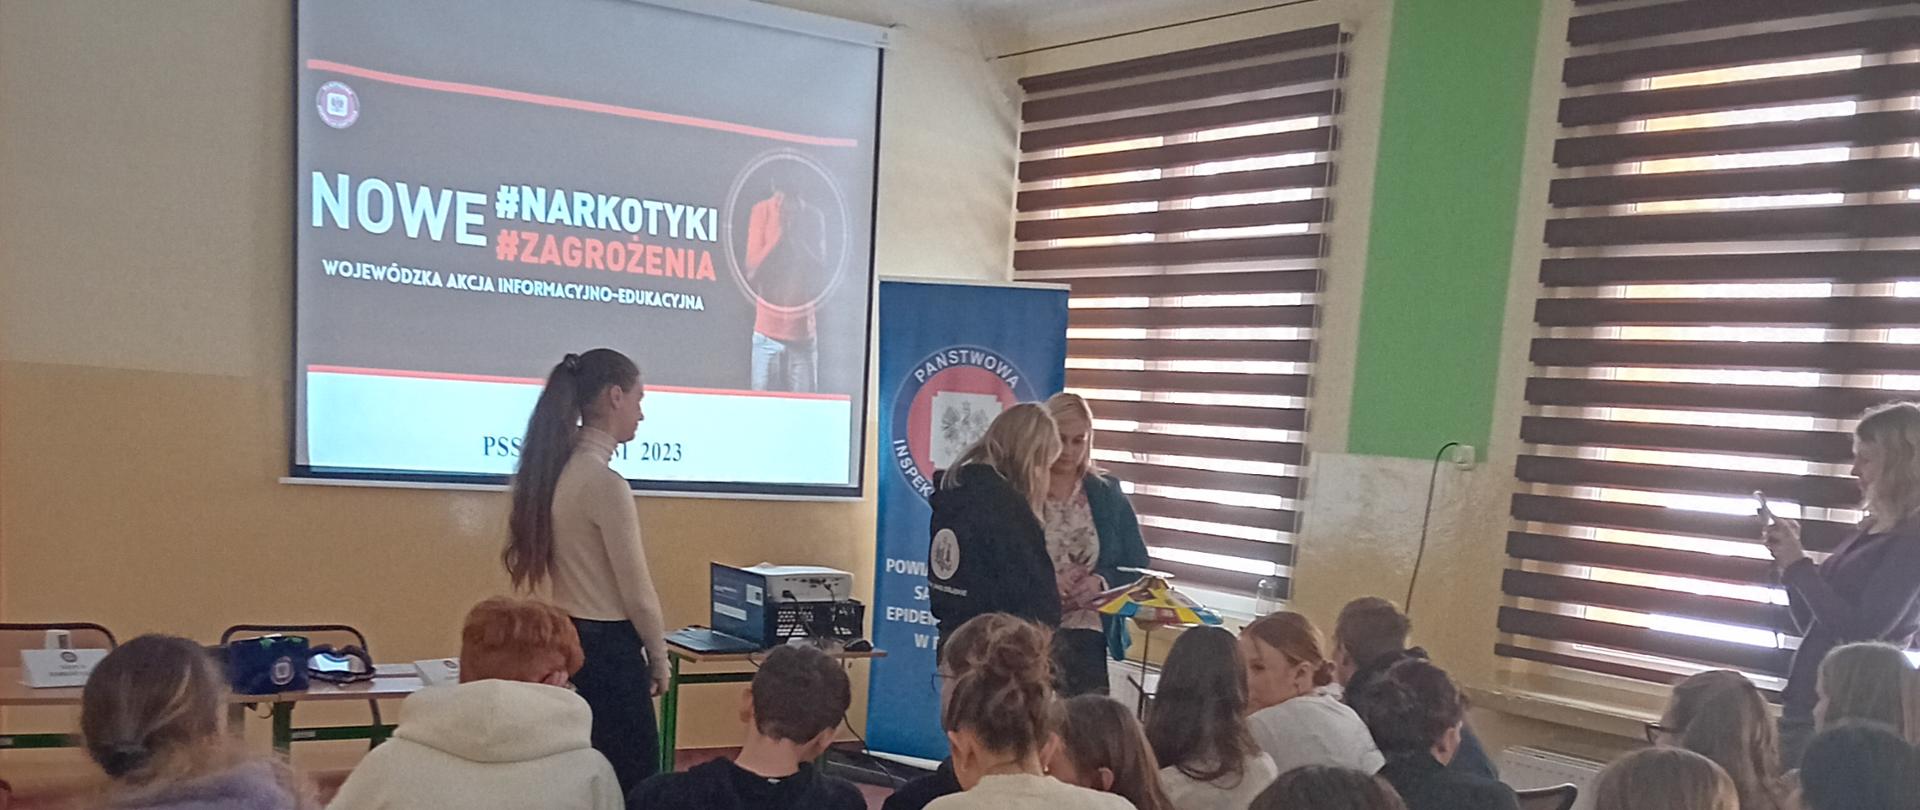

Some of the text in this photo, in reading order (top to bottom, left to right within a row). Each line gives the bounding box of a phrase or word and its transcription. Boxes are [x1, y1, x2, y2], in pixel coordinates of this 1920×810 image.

[311, 171, 487, 246] NOWE
[495, 184, 718, 241] #NARKOTYKI
[495, 228, 717, 281] #ZAGROŻENIA
[322, 259, 704, 311] WOJEWÓDZKA AKCJA INFORMACYJNO-EDUKACYJNA
[483, 436, 522, 457] PSS
[641, 442, 682, 461] 2023
[893, 439, 935, 497] INSPEK
[886, 558, 928, 576] POWI
[914, 633, 929, 648] W
